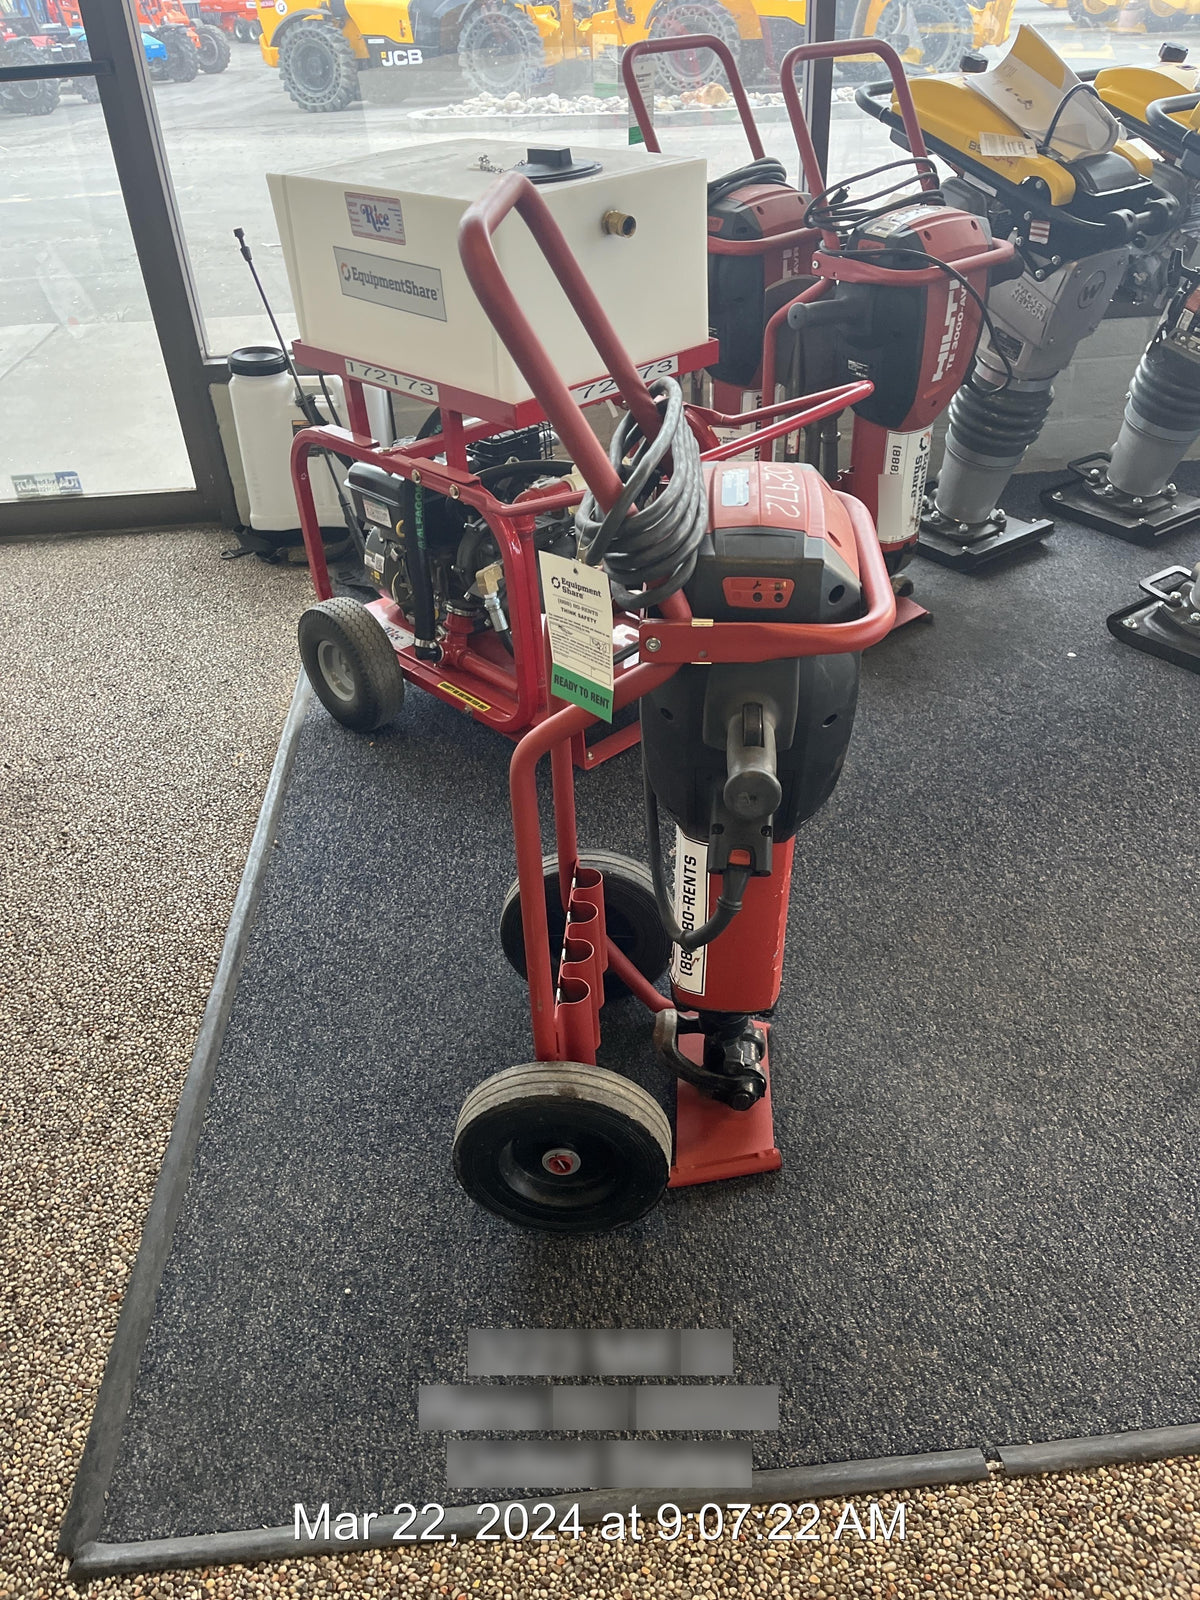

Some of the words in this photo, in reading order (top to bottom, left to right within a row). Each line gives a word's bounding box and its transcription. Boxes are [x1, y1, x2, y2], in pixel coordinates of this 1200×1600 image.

[381, 49, 424, 67] JCB
[360, 203, 391, 233] Rice
[350, 266, 439, 301] EquipmentShare
[931, 279, 961, 382] HILTI
[346, 360, 434, 397] 172173
[577, 359, 673, 399] 7273
[560, 577, 602, 598] Equipment
[561, 585, 583, 599] Share
[554, 674, 578, 693] READY
[579, 686, 589, 699] TO
[590, 693, 610, 709] RENT
[680, 950, 693, 976] (88
